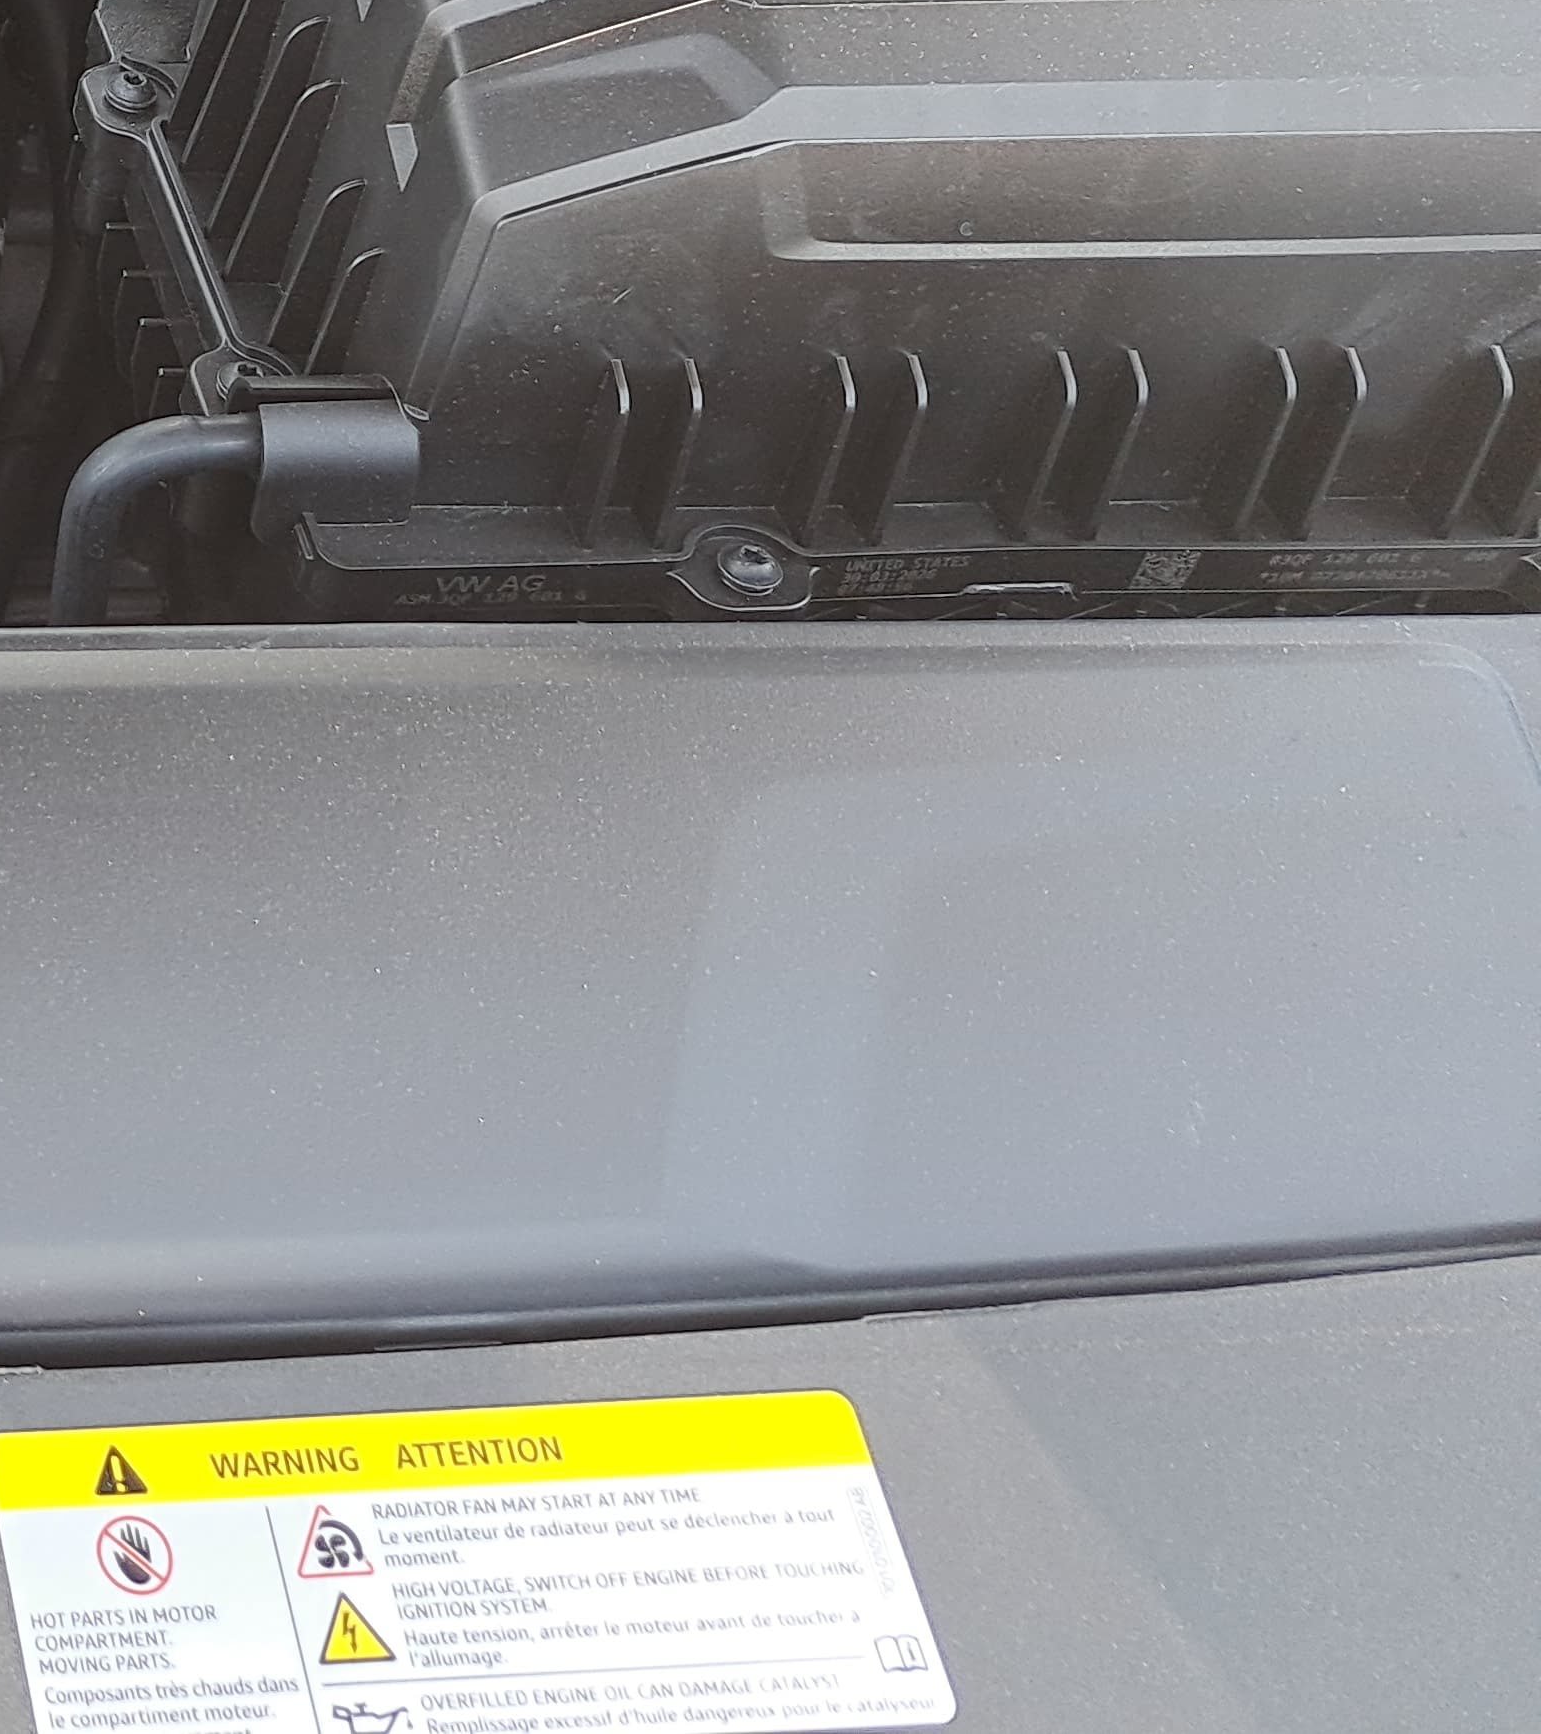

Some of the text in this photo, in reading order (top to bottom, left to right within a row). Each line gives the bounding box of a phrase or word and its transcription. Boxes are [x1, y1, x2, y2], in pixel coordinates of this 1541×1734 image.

[210, 1434, 564, 1479] WARNING ATTENTION
[371, 1485, 702, 1520] RADIATOR FAN MAY START AT ANY TIME
[378, 1507, 836, 1546] Le ventilateur de radiateur peut se déclencher à tout
[384, 1548, 465, 1568] moment.
[392, 1558, 866, 1600] HIGH VOLTAGE, SWITCH OFF ENGINE BEFORE TOUCHING
[29, 1604, 218, 1630] HOT PARTS IN MOTOR
[396, 1600, 477, 1621] IGNITION
[34, 1629, 174, 1654] COMPARTMENT.
[403, 1627, 459, 1648] Haute
[466, 1625, 535, 1645] tension,
[539, 1620, 600, 1640] arrêter
[603, 1618, 620, 1636] le
[626, 1616, 691, 1636] moteur
[696, 1612, 746, 1632] avant
[751, 1610, 772, 1628] de
[776, 1608, 845, 1627] toucher
[38, 1652, 176, 1675] MOVING PARTS.
[407, 1648, 509, 1669] l'allumage.
[44, 1674, 300, 1707] Composants très chauds dans
[419, 1688, 528, 1712] OVERFILLED
[533, 1686, 599, 1706] ENGINE
[603, 1684, 631, 1702] OIL
[637, 1682, 675, 1701] CAN
[679, 1677, 753, 1700] DAMAGE
[48, 1703, 276, 1731] le compartiment moteur.
[426, 1712, 536, 1734] Remplissage
[536, 1710, 613, 1729] excessif
[617, 1706, 678, 1727] d'huile
[683, 1702, 777, 1726] dangereux
